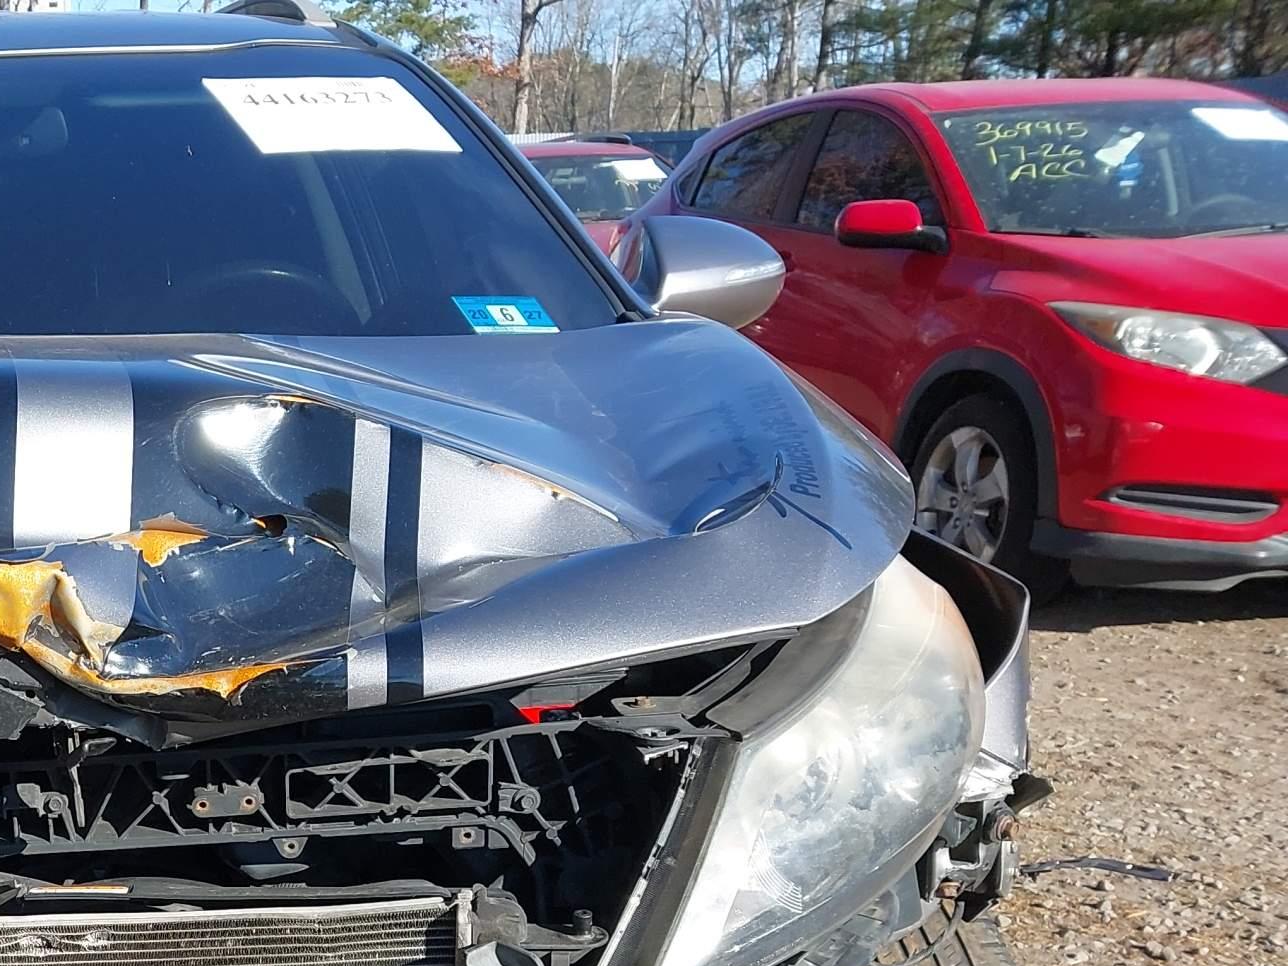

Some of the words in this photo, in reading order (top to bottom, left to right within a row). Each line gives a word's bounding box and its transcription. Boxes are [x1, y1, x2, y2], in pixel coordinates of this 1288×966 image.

[242, 91, 393, 106] 44163273
[975, 121, 1089, 146] 369915
[1009, 158, 1091, 182] ACC
[468, 309, 488, 320] 20
[499, 307, 515, 322] 6
